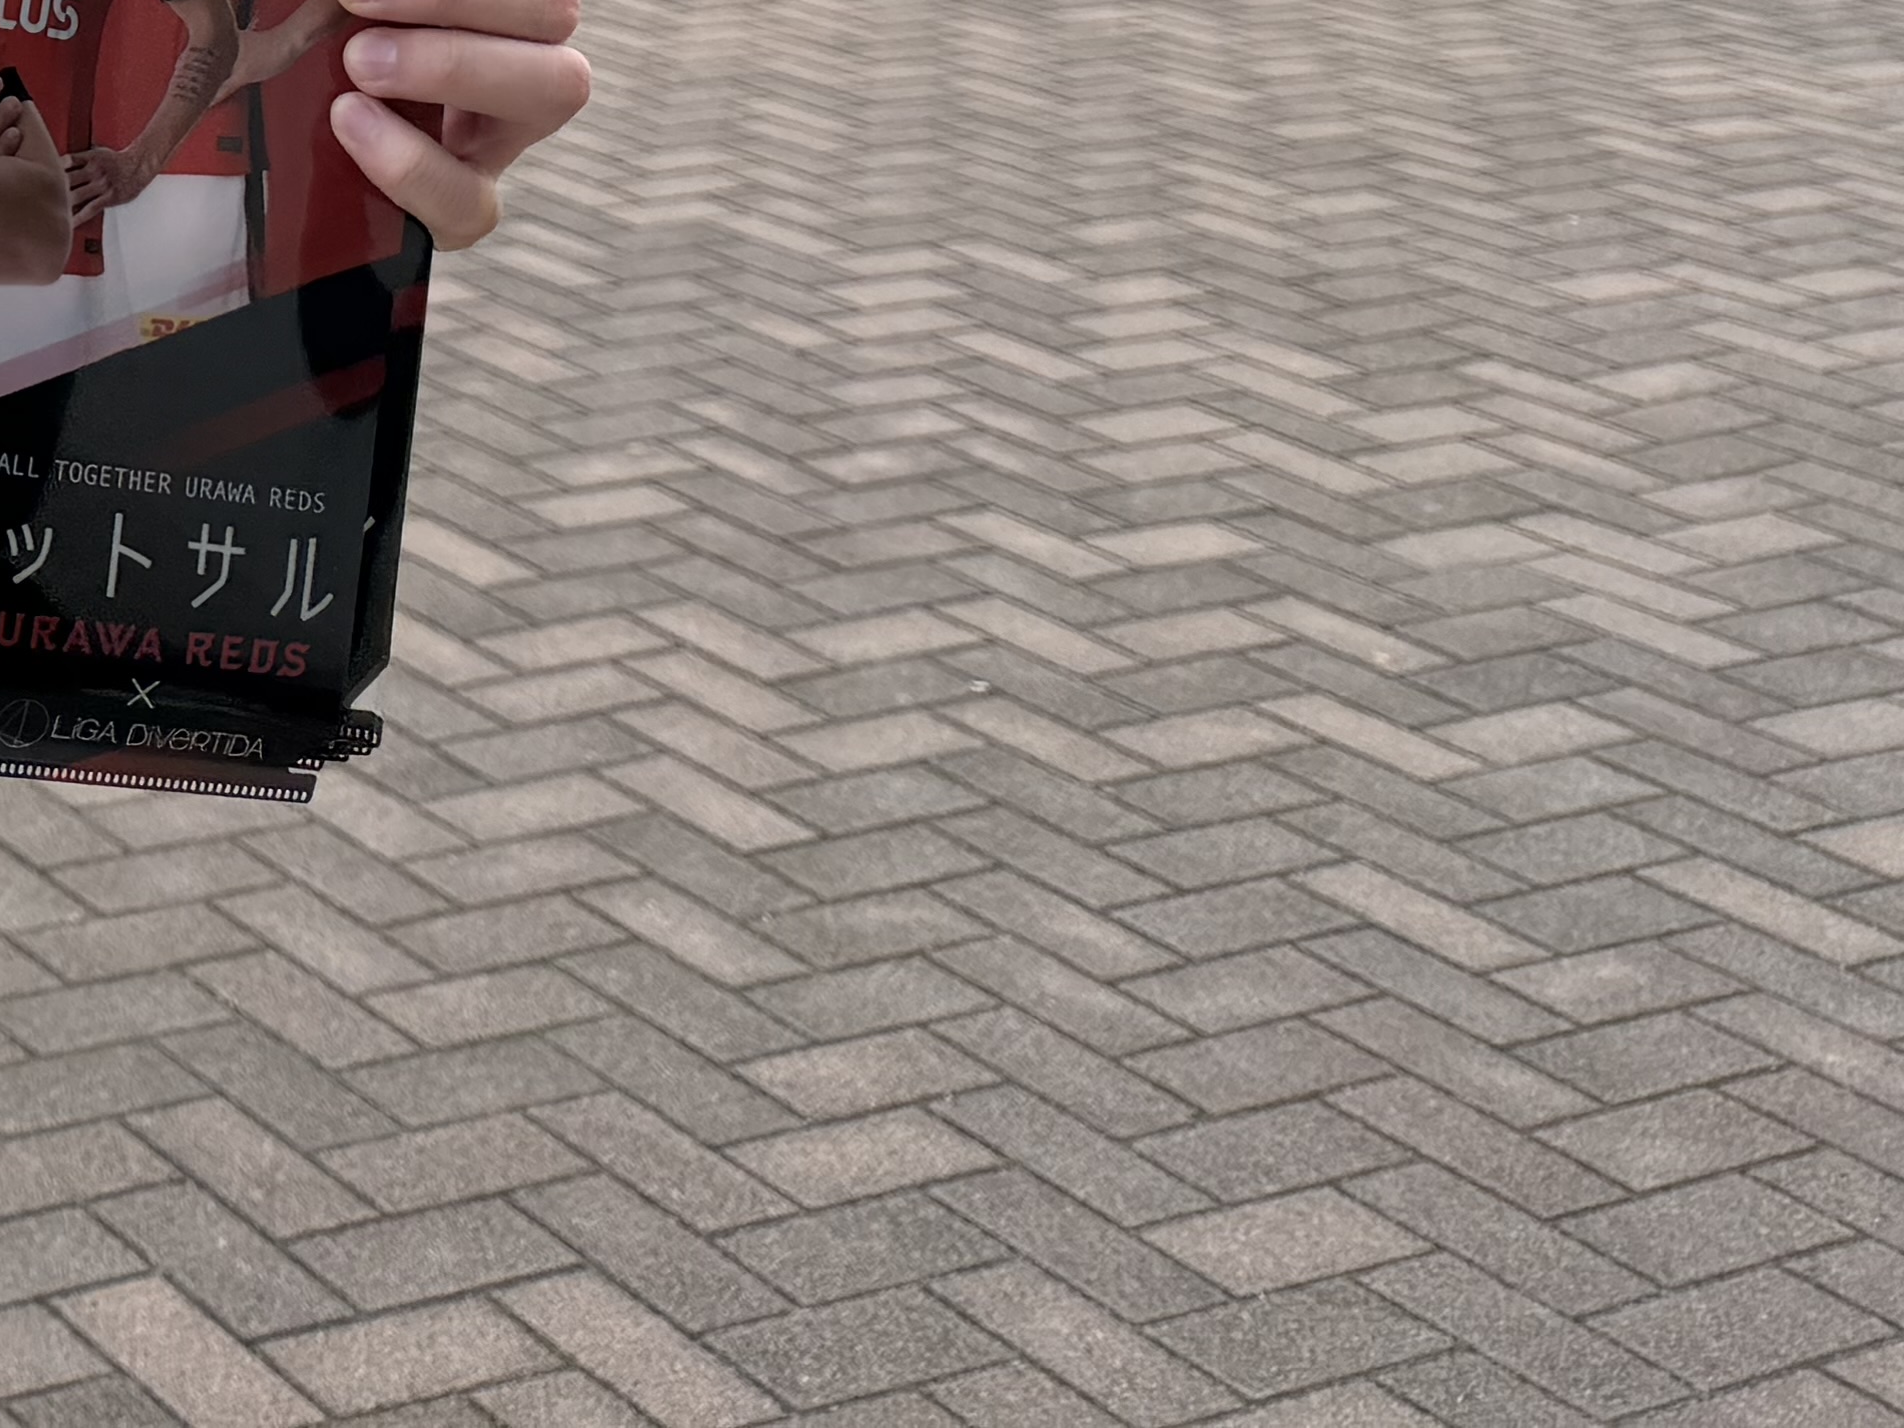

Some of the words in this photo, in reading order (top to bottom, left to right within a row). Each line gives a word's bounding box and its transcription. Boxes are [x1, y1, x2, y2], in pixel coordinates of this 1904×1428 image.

[54, 458, 173, 497] TOGETHER
[184, 475, 257, 506] URAWA
[268, 487, 327, 515] REDS
[185, 630, 312, 678] REDS
